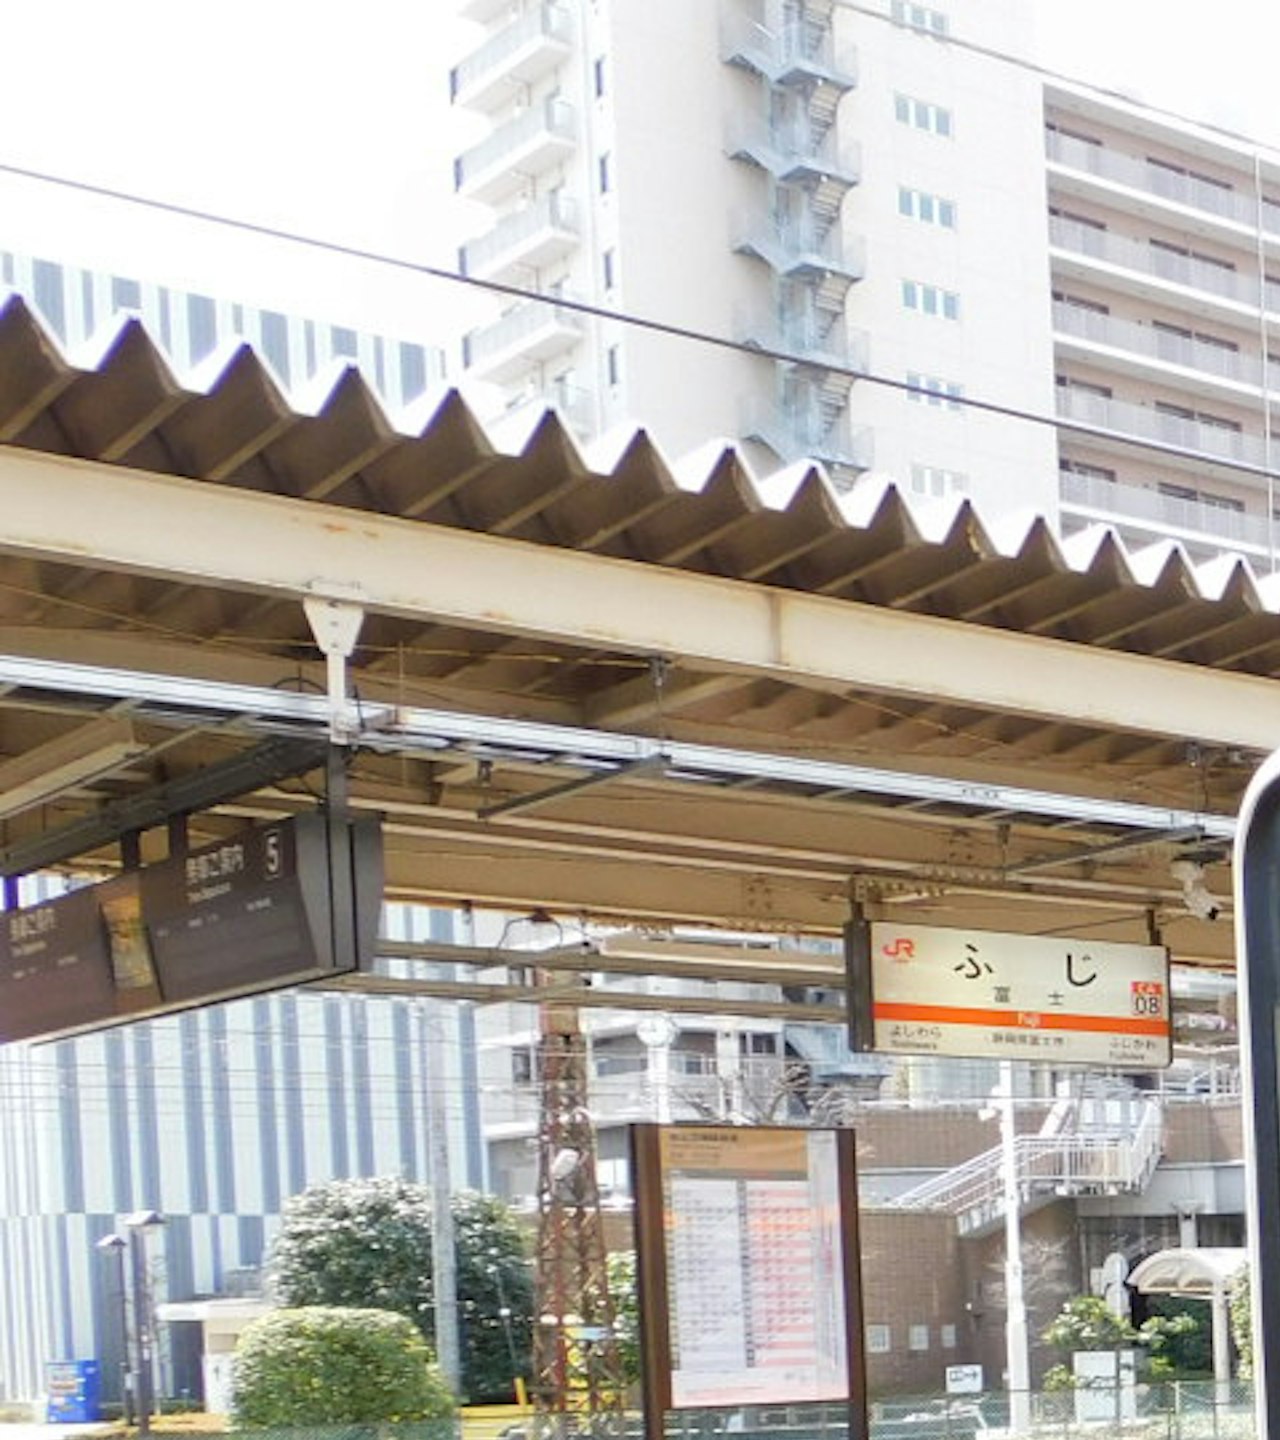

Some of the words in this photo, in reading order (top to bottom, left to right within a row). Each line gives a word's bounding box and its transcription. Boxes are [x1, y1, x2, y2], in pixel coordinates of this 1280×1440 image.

[265, 832, 280, 873] 5
[882, 938, 915, 958] JR
[953, 943, 1097, 987] ふじ
[993, 985, 1065, 1006] 富士
[1135, 997, 1159, 1015] 08
[1017, 1012, 1041, 1028] Fuji
